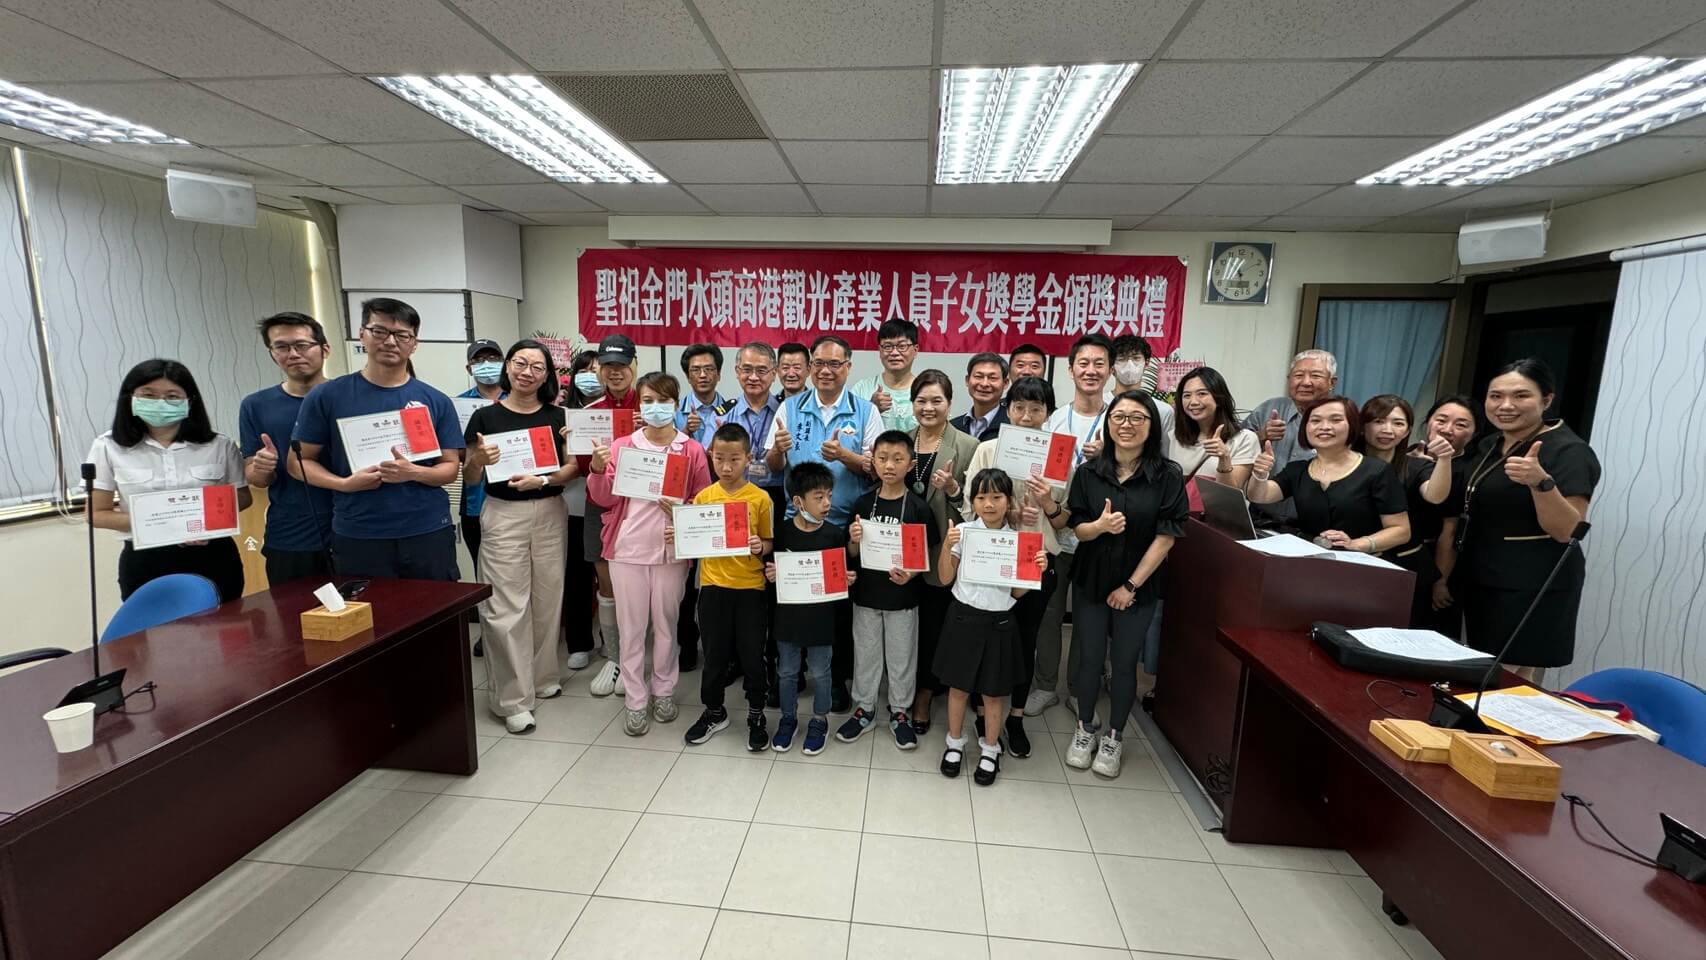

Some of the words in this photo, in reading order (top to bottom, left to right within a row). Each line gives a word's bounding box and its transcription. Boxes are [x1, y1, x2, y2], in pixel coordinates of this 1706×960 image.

[595, 267, 1168, 337] 聖祖金門水頭商港觀光產業人員子女獎學金頒獎典禮
